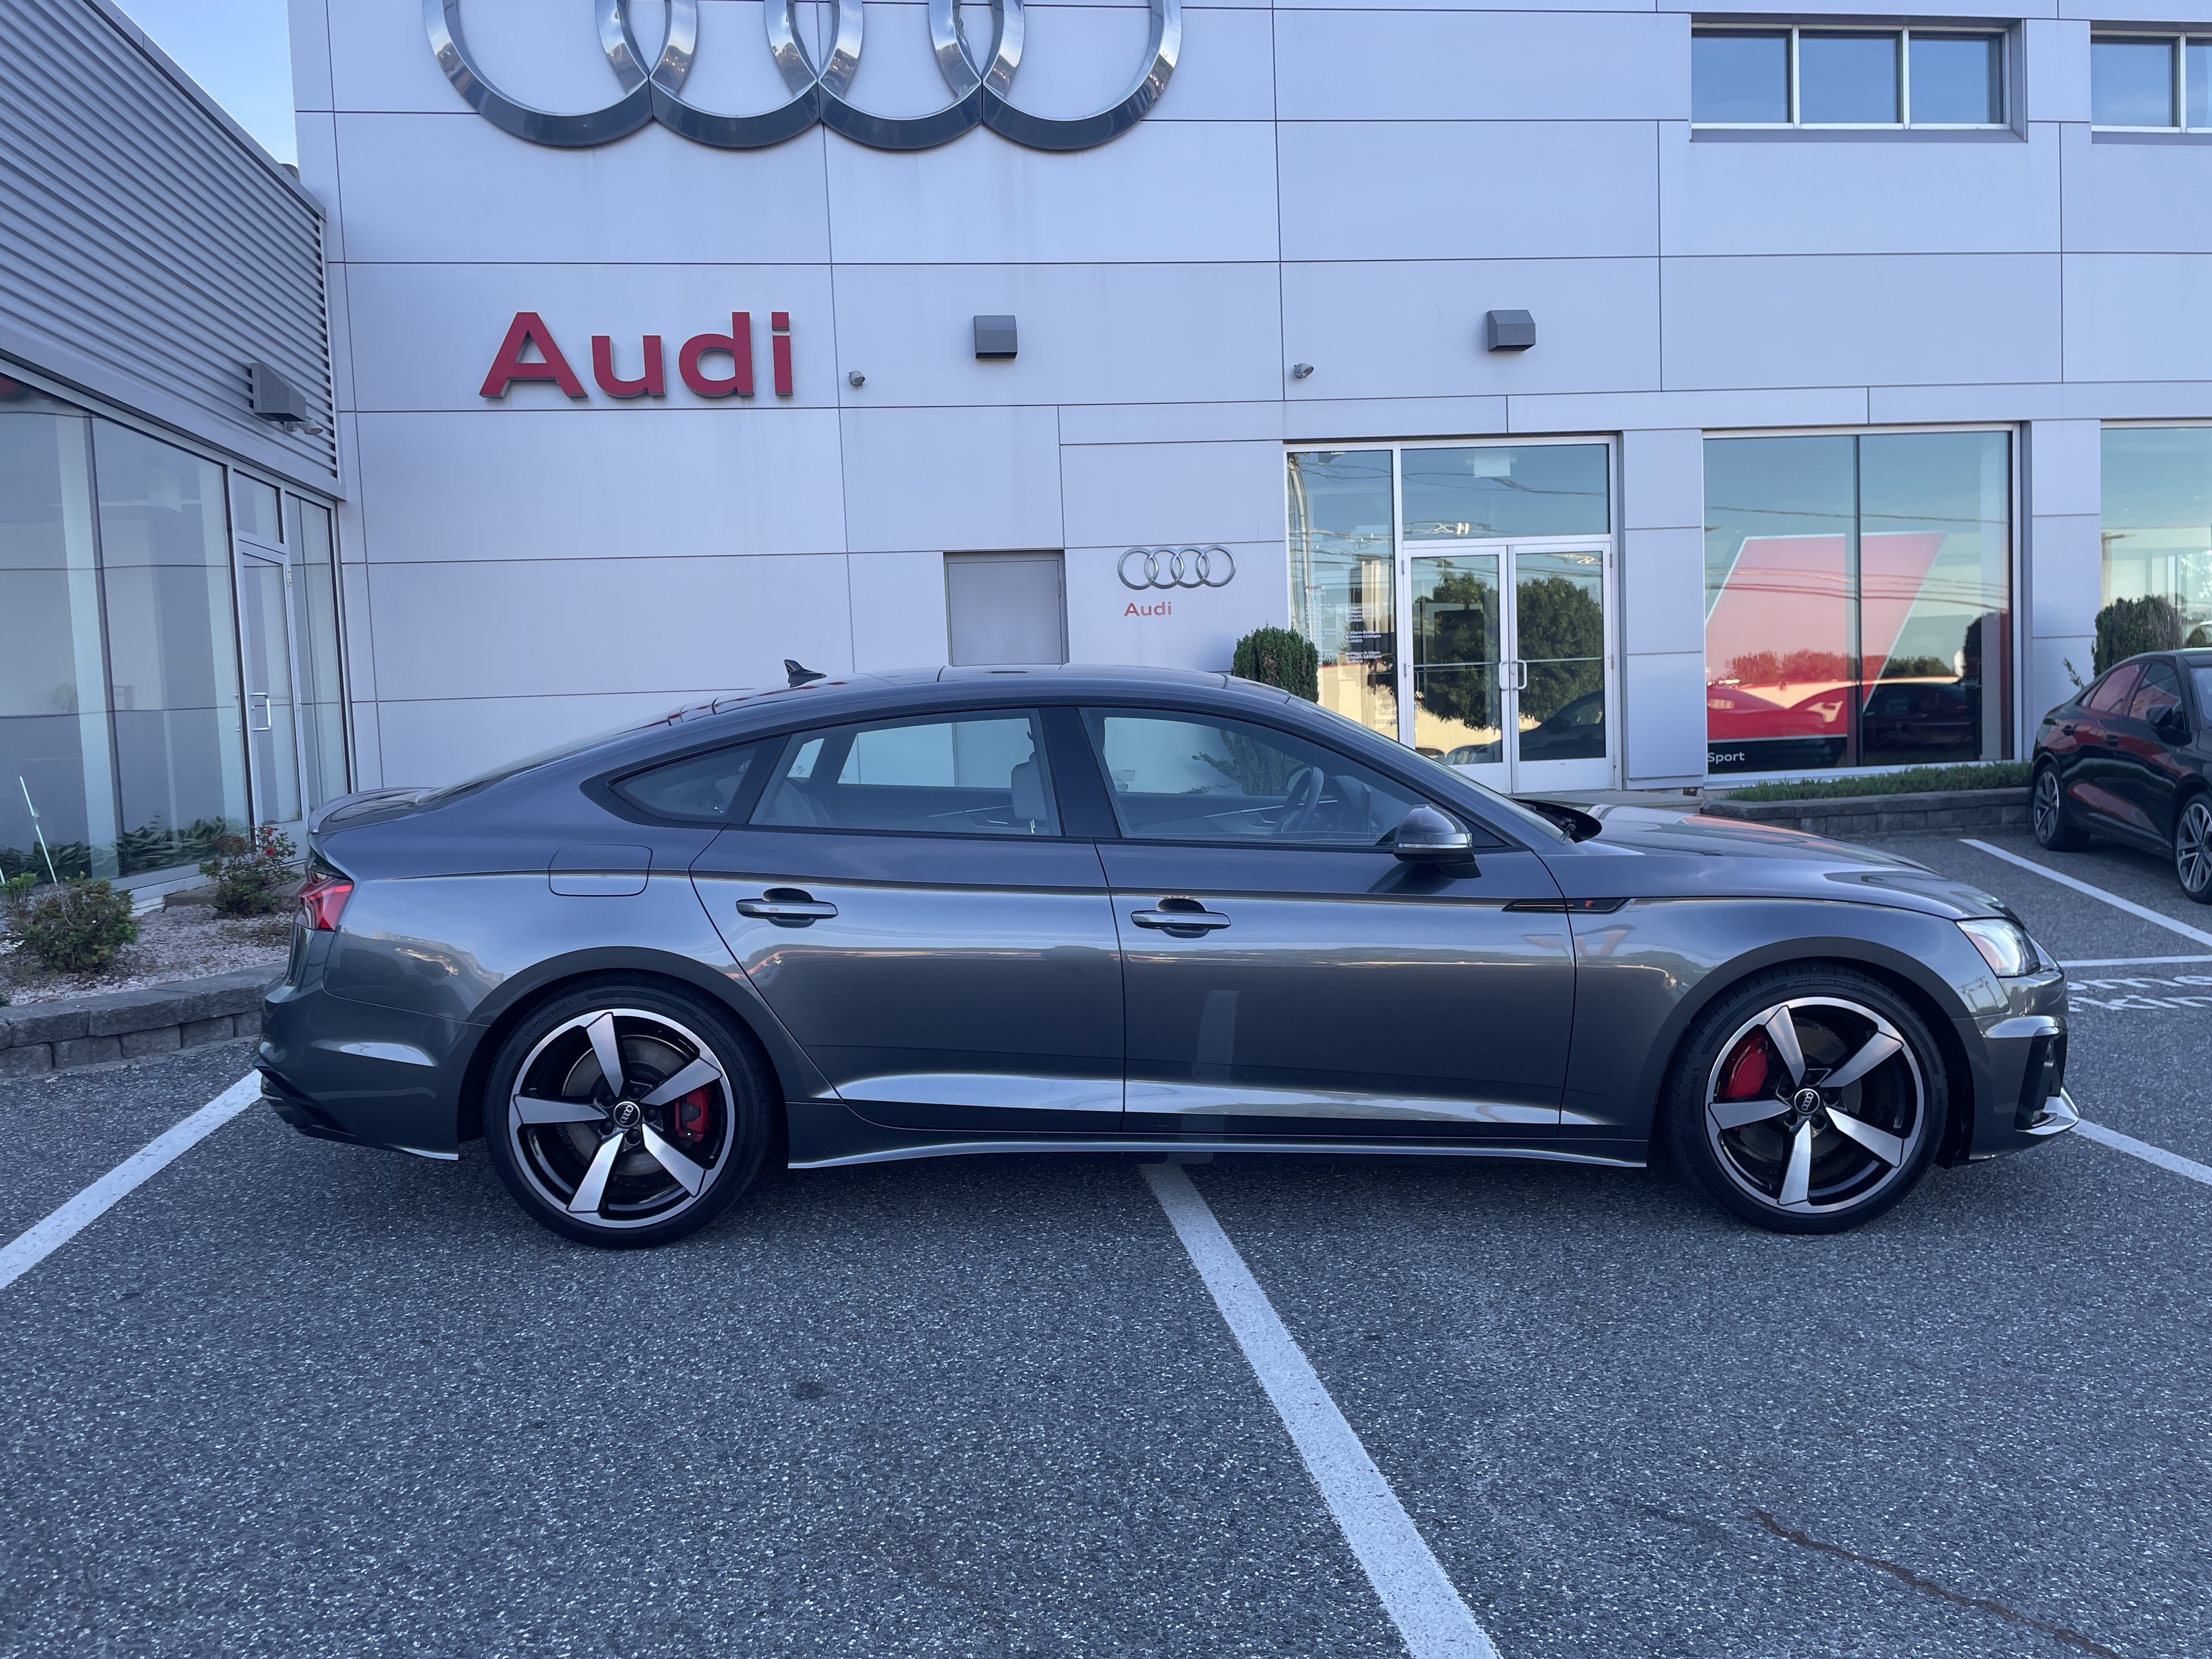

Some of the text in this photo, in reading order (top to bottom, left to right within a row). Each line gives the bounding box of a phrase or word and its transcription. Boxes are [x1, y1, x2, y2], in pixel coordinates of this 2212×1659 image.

[479, 311, 793, 400] Audi
[1124, 601, 1172, 617] Audi
[1708, 751, 1745, 764] Sport
